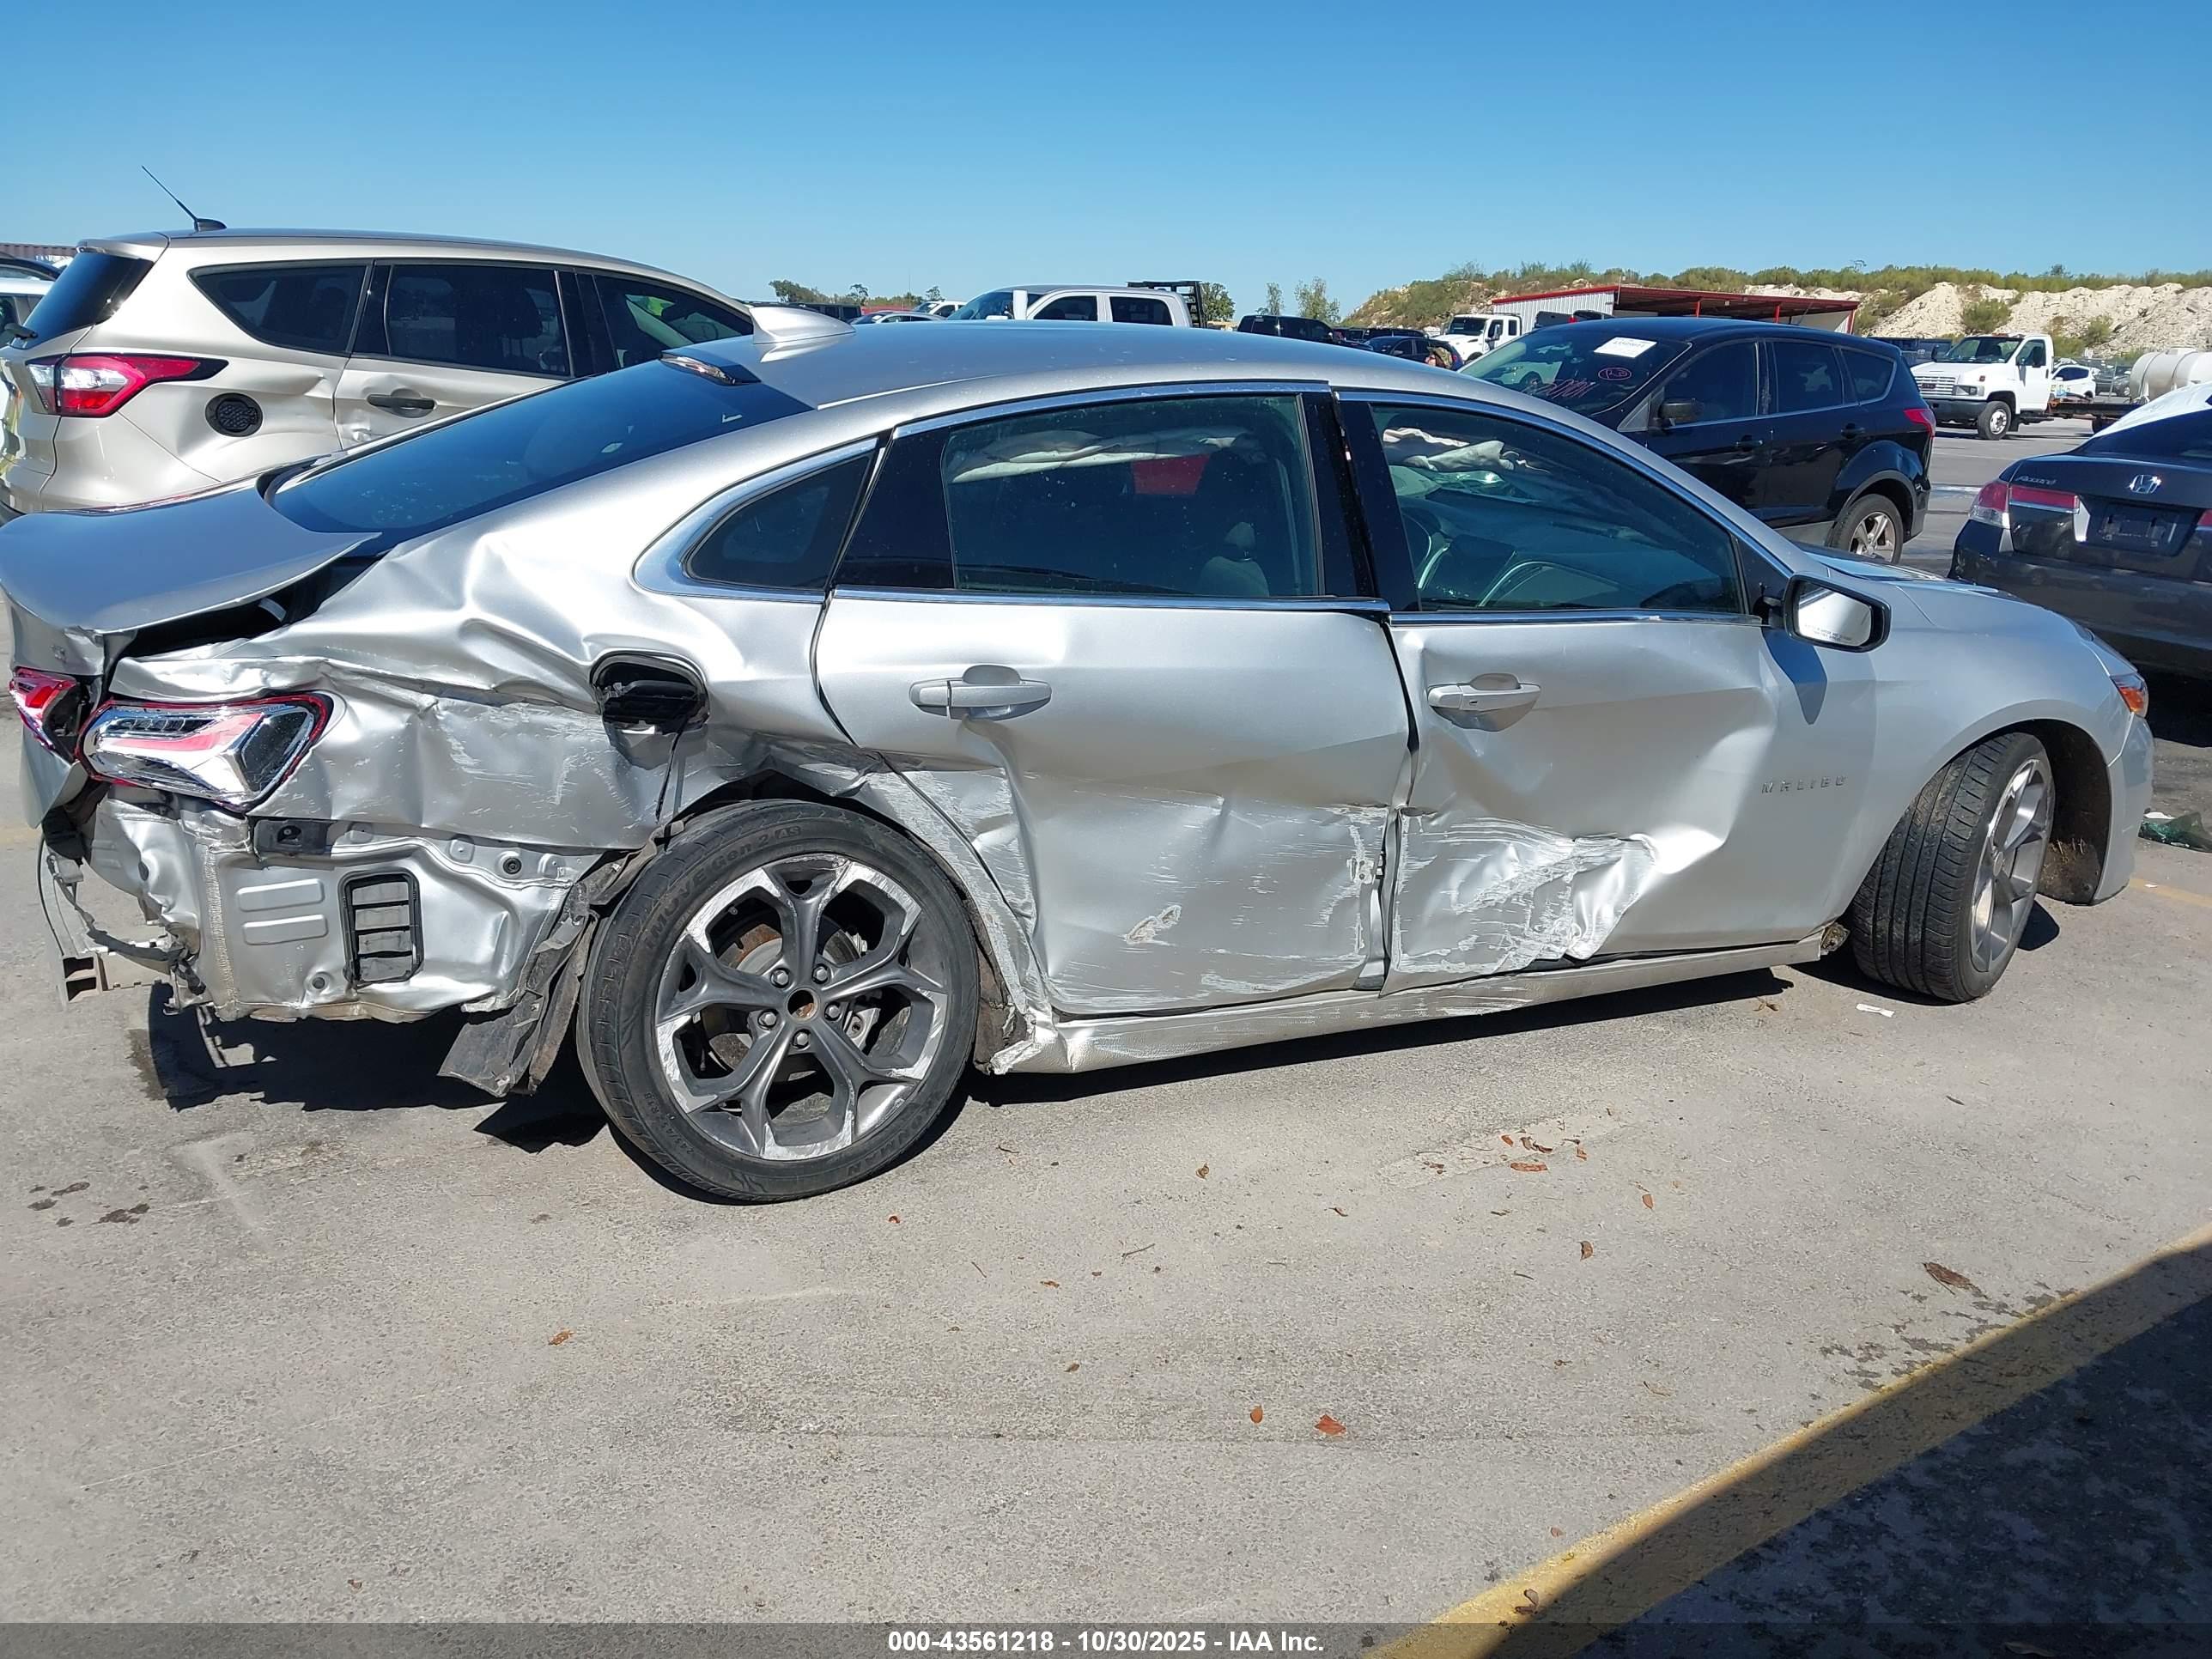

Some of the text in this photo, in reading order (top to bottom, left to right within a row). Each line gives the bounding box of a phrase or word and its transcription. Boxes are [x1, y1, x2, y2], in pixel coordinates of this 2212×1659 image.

[2015, 476, 2057, 484] Accord
[1762, 775, 1848, 793] MALIBU
[757, 834, 769, 848] 2
